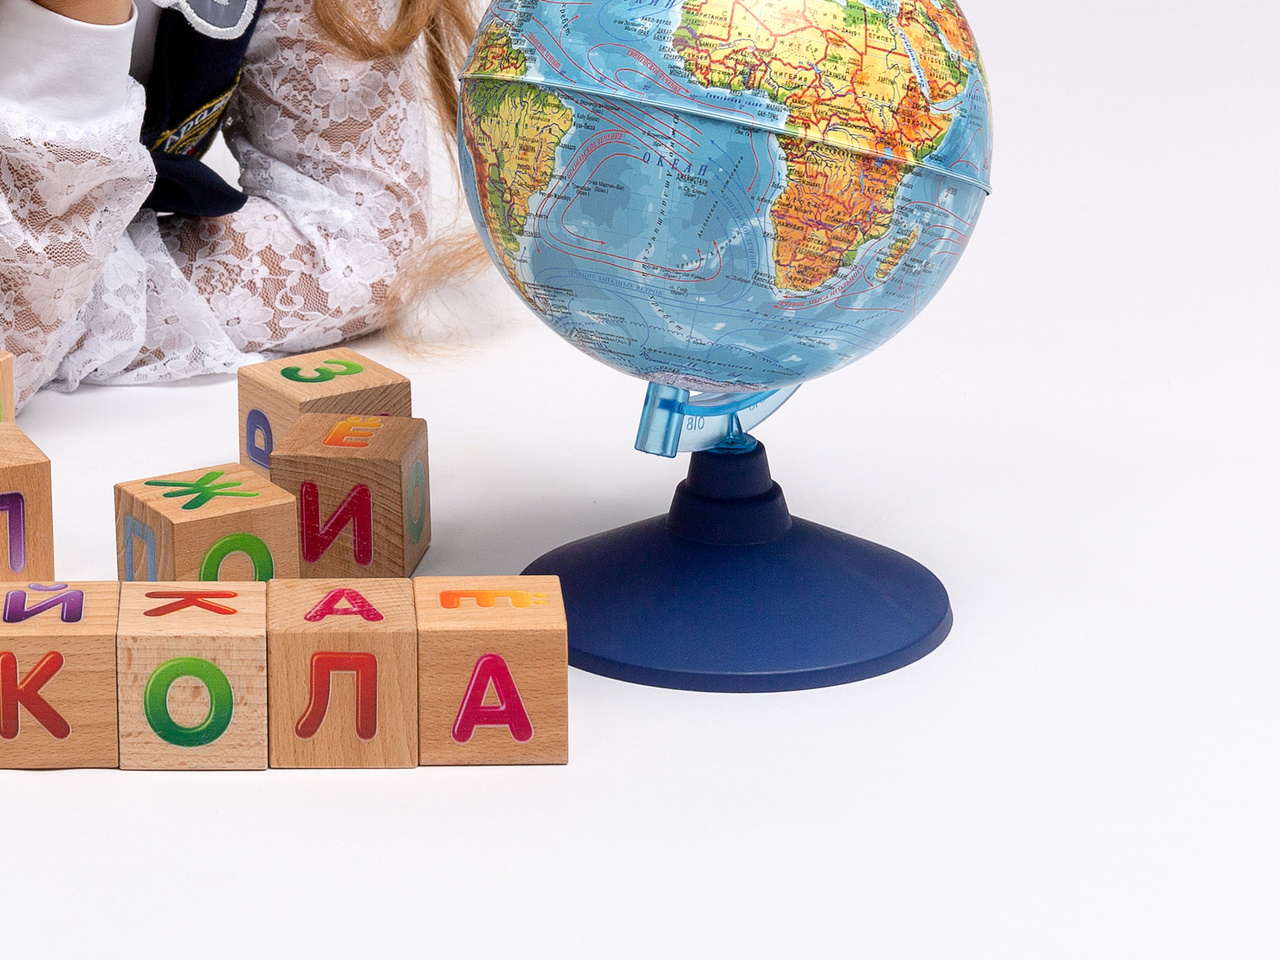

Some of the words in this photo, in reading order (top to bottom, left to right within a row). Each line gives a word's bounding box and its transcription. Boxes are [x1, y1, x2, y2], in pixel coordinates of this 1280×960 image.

[643, 152, 708, 176] ОКЕАН
[144, 471, 260, 510] Ж
[303, 588, 385, 623] А
